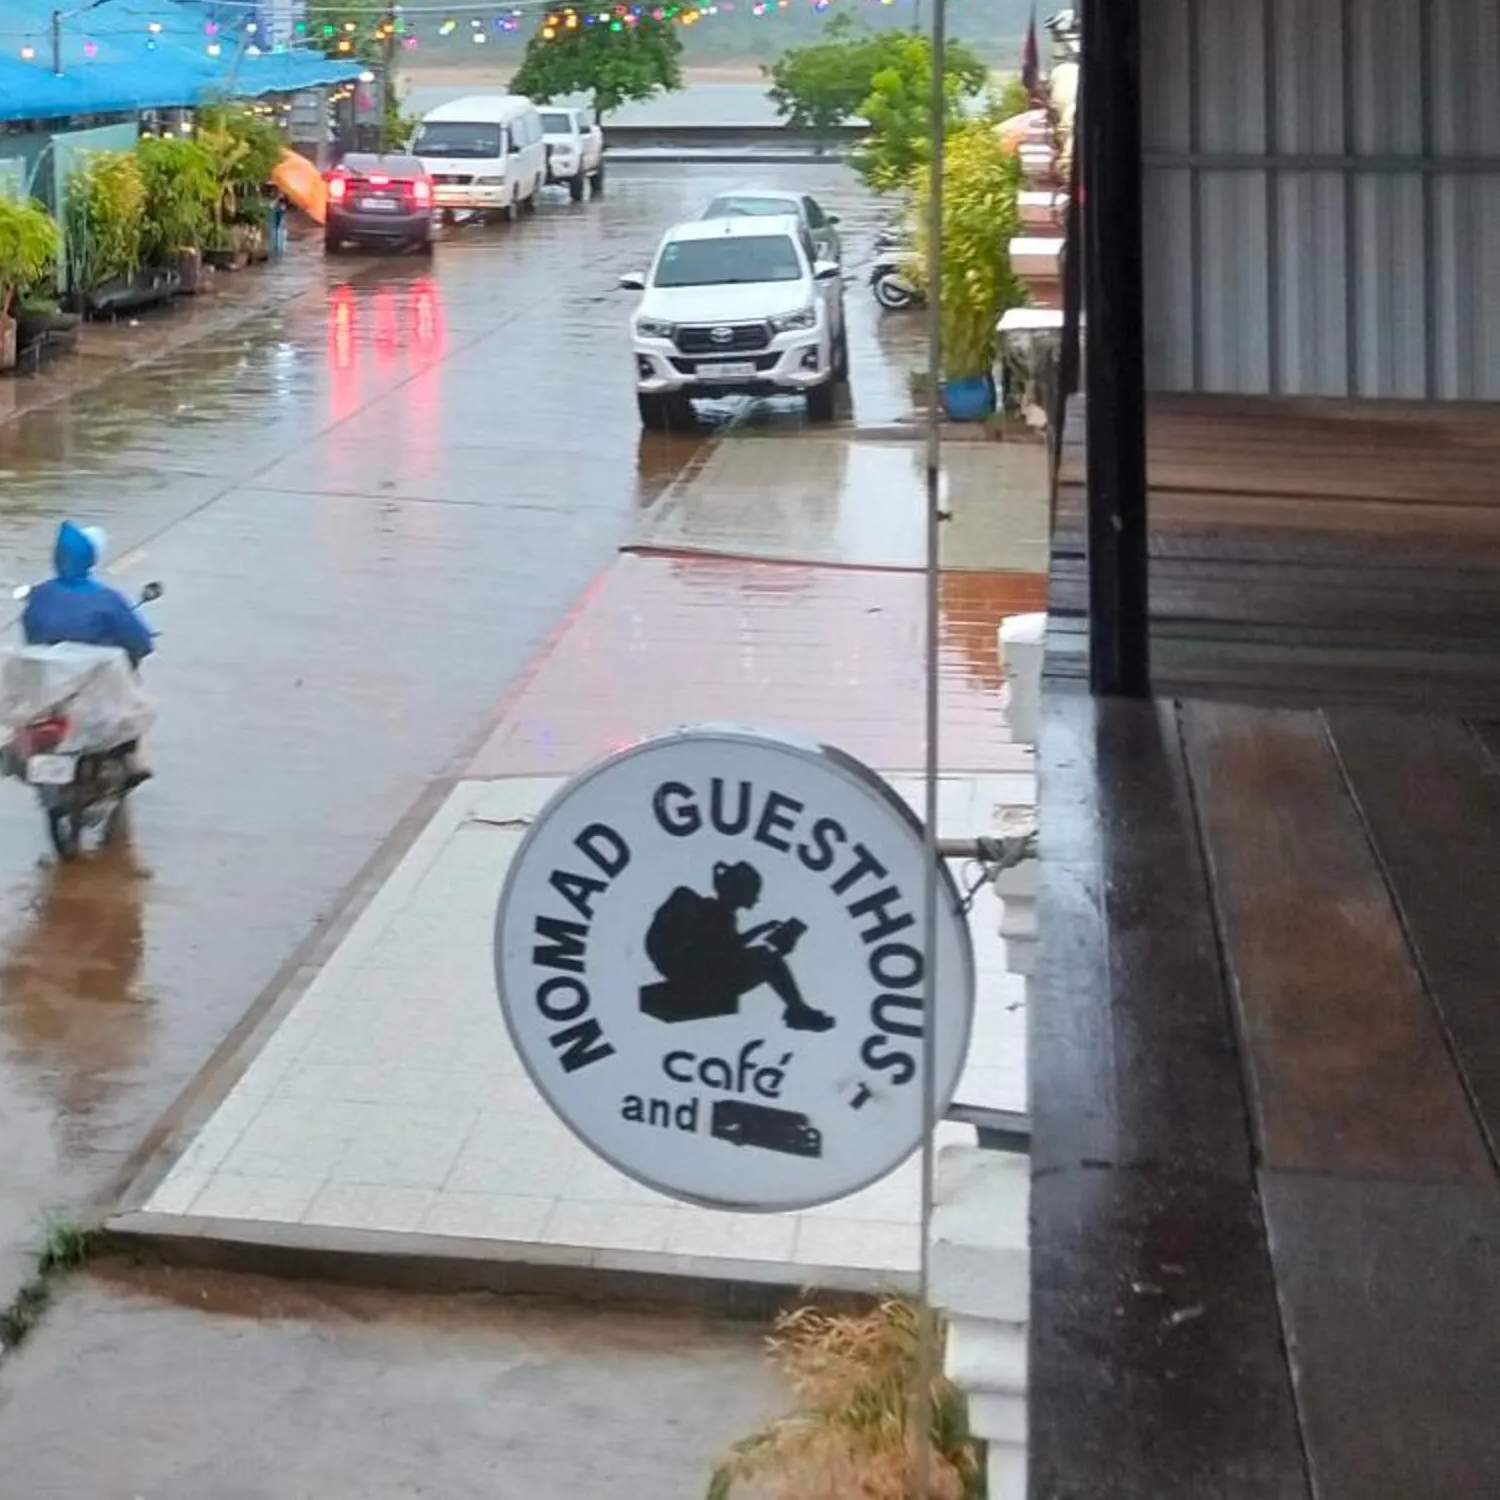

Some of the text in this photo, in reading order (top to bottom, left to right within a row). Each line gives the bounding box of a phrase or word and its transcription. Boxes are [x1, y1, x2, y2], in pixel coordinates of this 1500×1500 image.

[532, 823, 631, 1074] NOMAD
[662, 1038, 794, 1098] café
[621, 1094, 698, 1133] and
